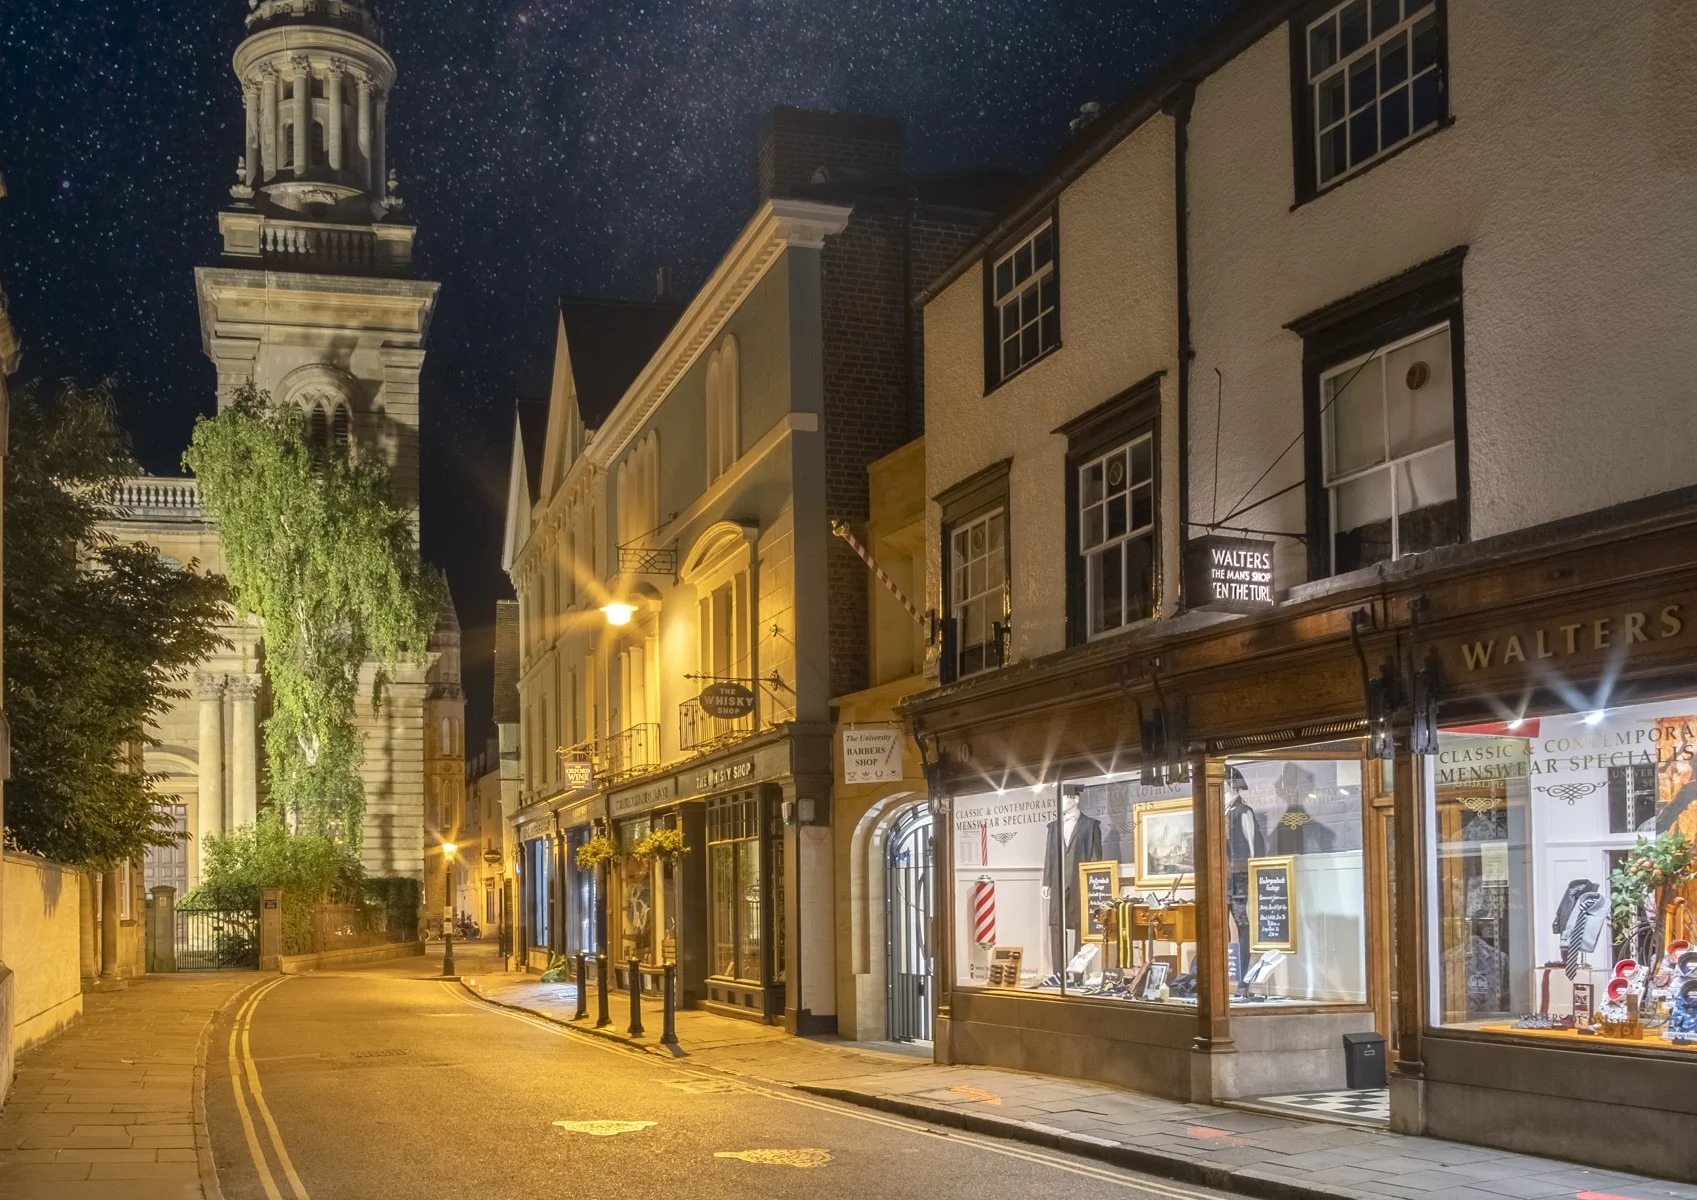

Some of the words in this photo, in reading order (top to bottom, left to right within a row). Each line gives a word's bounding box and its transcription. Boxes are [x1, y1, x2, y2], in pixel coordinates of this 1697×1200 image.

[1211, 548, 1270, 569] WALTERS
[1211, 568, 1225, 579] THE
[1251, 572, 1271, 583] SHOP
[1230, 583, 1249, 601] THE
[1460, 604, 1683, 671] WALTERS
[704, 695, 753, 707] WHISKY
[845, 734, 859, 742] The
[860, 733, 892, 742] University
[846, 746, 886, 756] BARBERS
[1439, 744, 1513, 764] CLASSIC
[1523, 742, 1535, 755] &
[733, 762, 751, 779] SHOP
[855, 758, 878, 767] SHOP
[1440, 758, 1559, 783] MENSWEAR
[955, 807, 984, 820] CLASSIC
[986, 807, 991, 816] &
[993, 798, 1057, 815] CONTEMPORARY
[955, 817, 999, 831] MENSWEAR
[1002, 810, 1057, 826] SPECIALISTS
